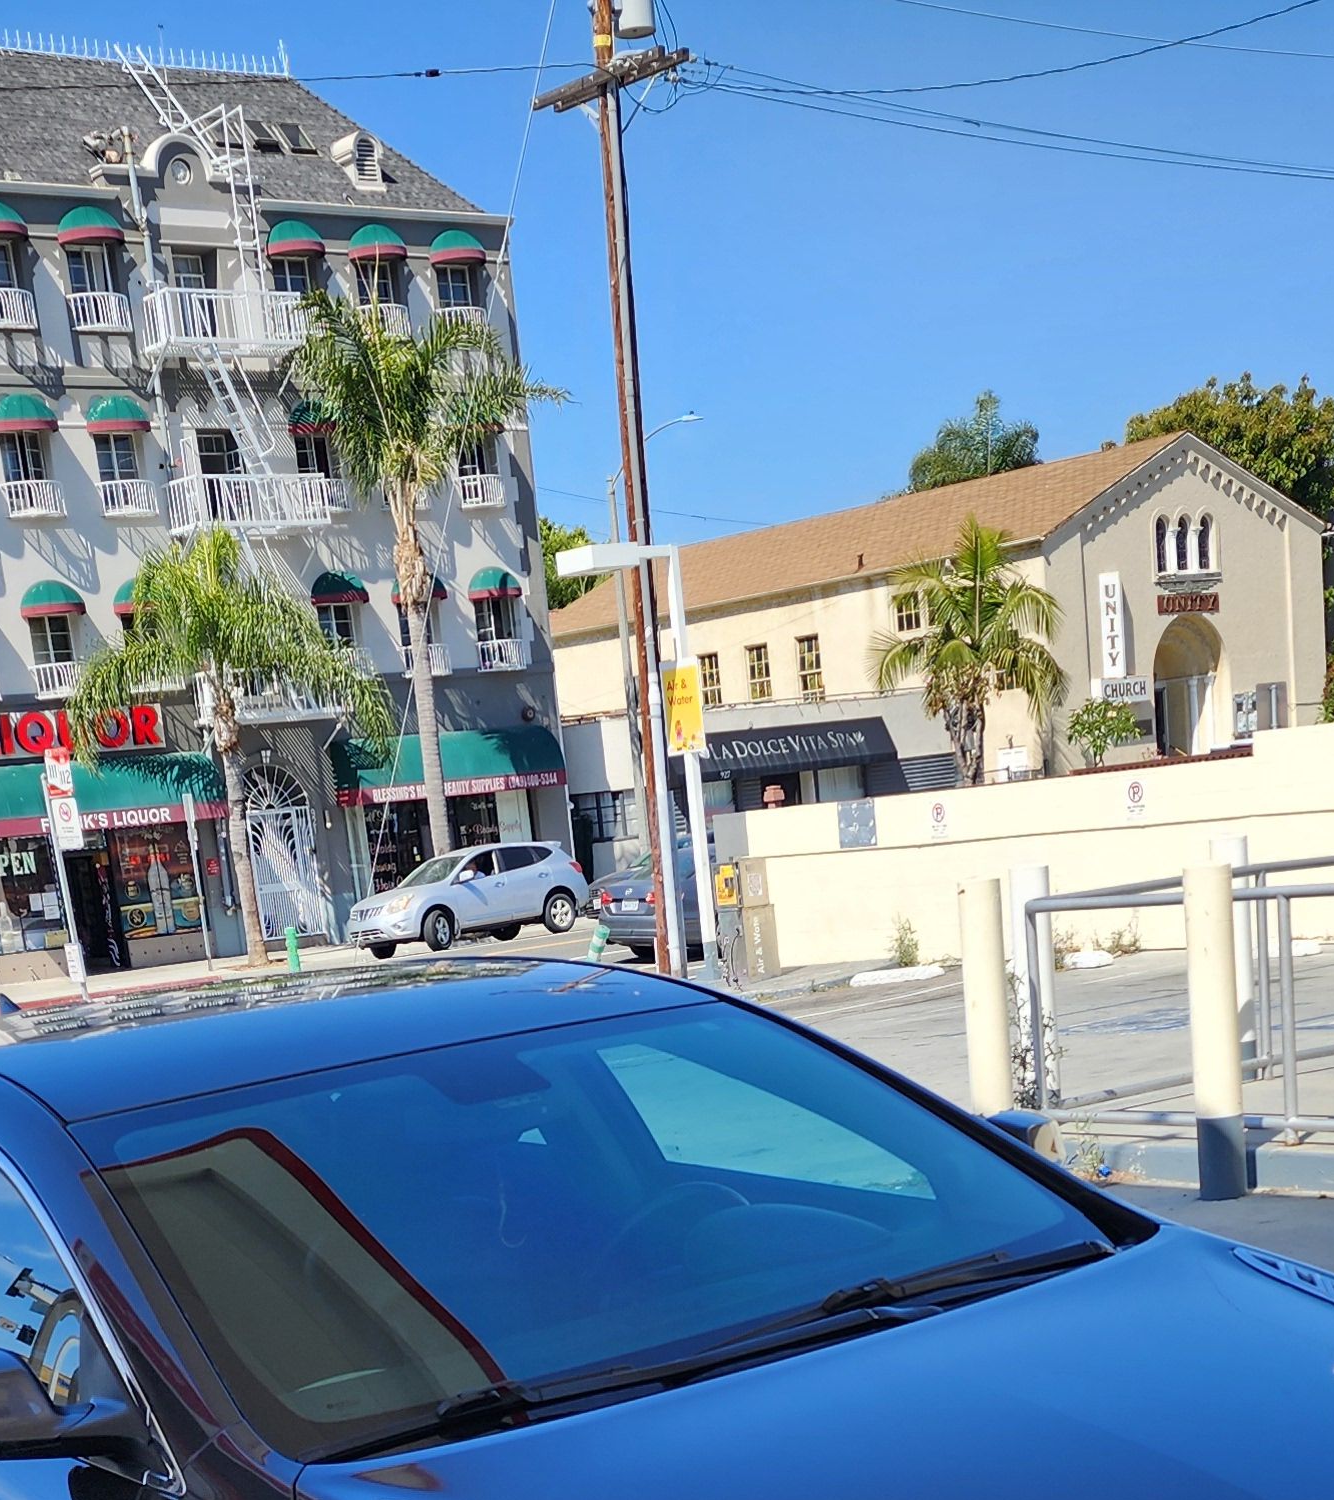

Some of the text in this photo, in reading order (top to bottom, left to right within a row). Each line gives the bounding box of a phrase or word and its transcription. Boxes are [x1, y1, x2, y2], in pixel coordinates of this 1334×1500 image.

[1163, 594, 1218, 612] UNITY
[1104, 583, 1120, 667] UNITY
[667, 679, 687, 691] Air &
[1104, 681, 1147, 699] CHURCH
[667, 696, 694, 706] Water
[709, 731, 857, 760] LA DOLCE VITA SPA
[59, 770, 71, 785] 112
[372, 785, 416, 804] BLESSING'S
[470, 776, 506, 794] SUPPLIES
[112, 807, 172, 827] LIQUOR
